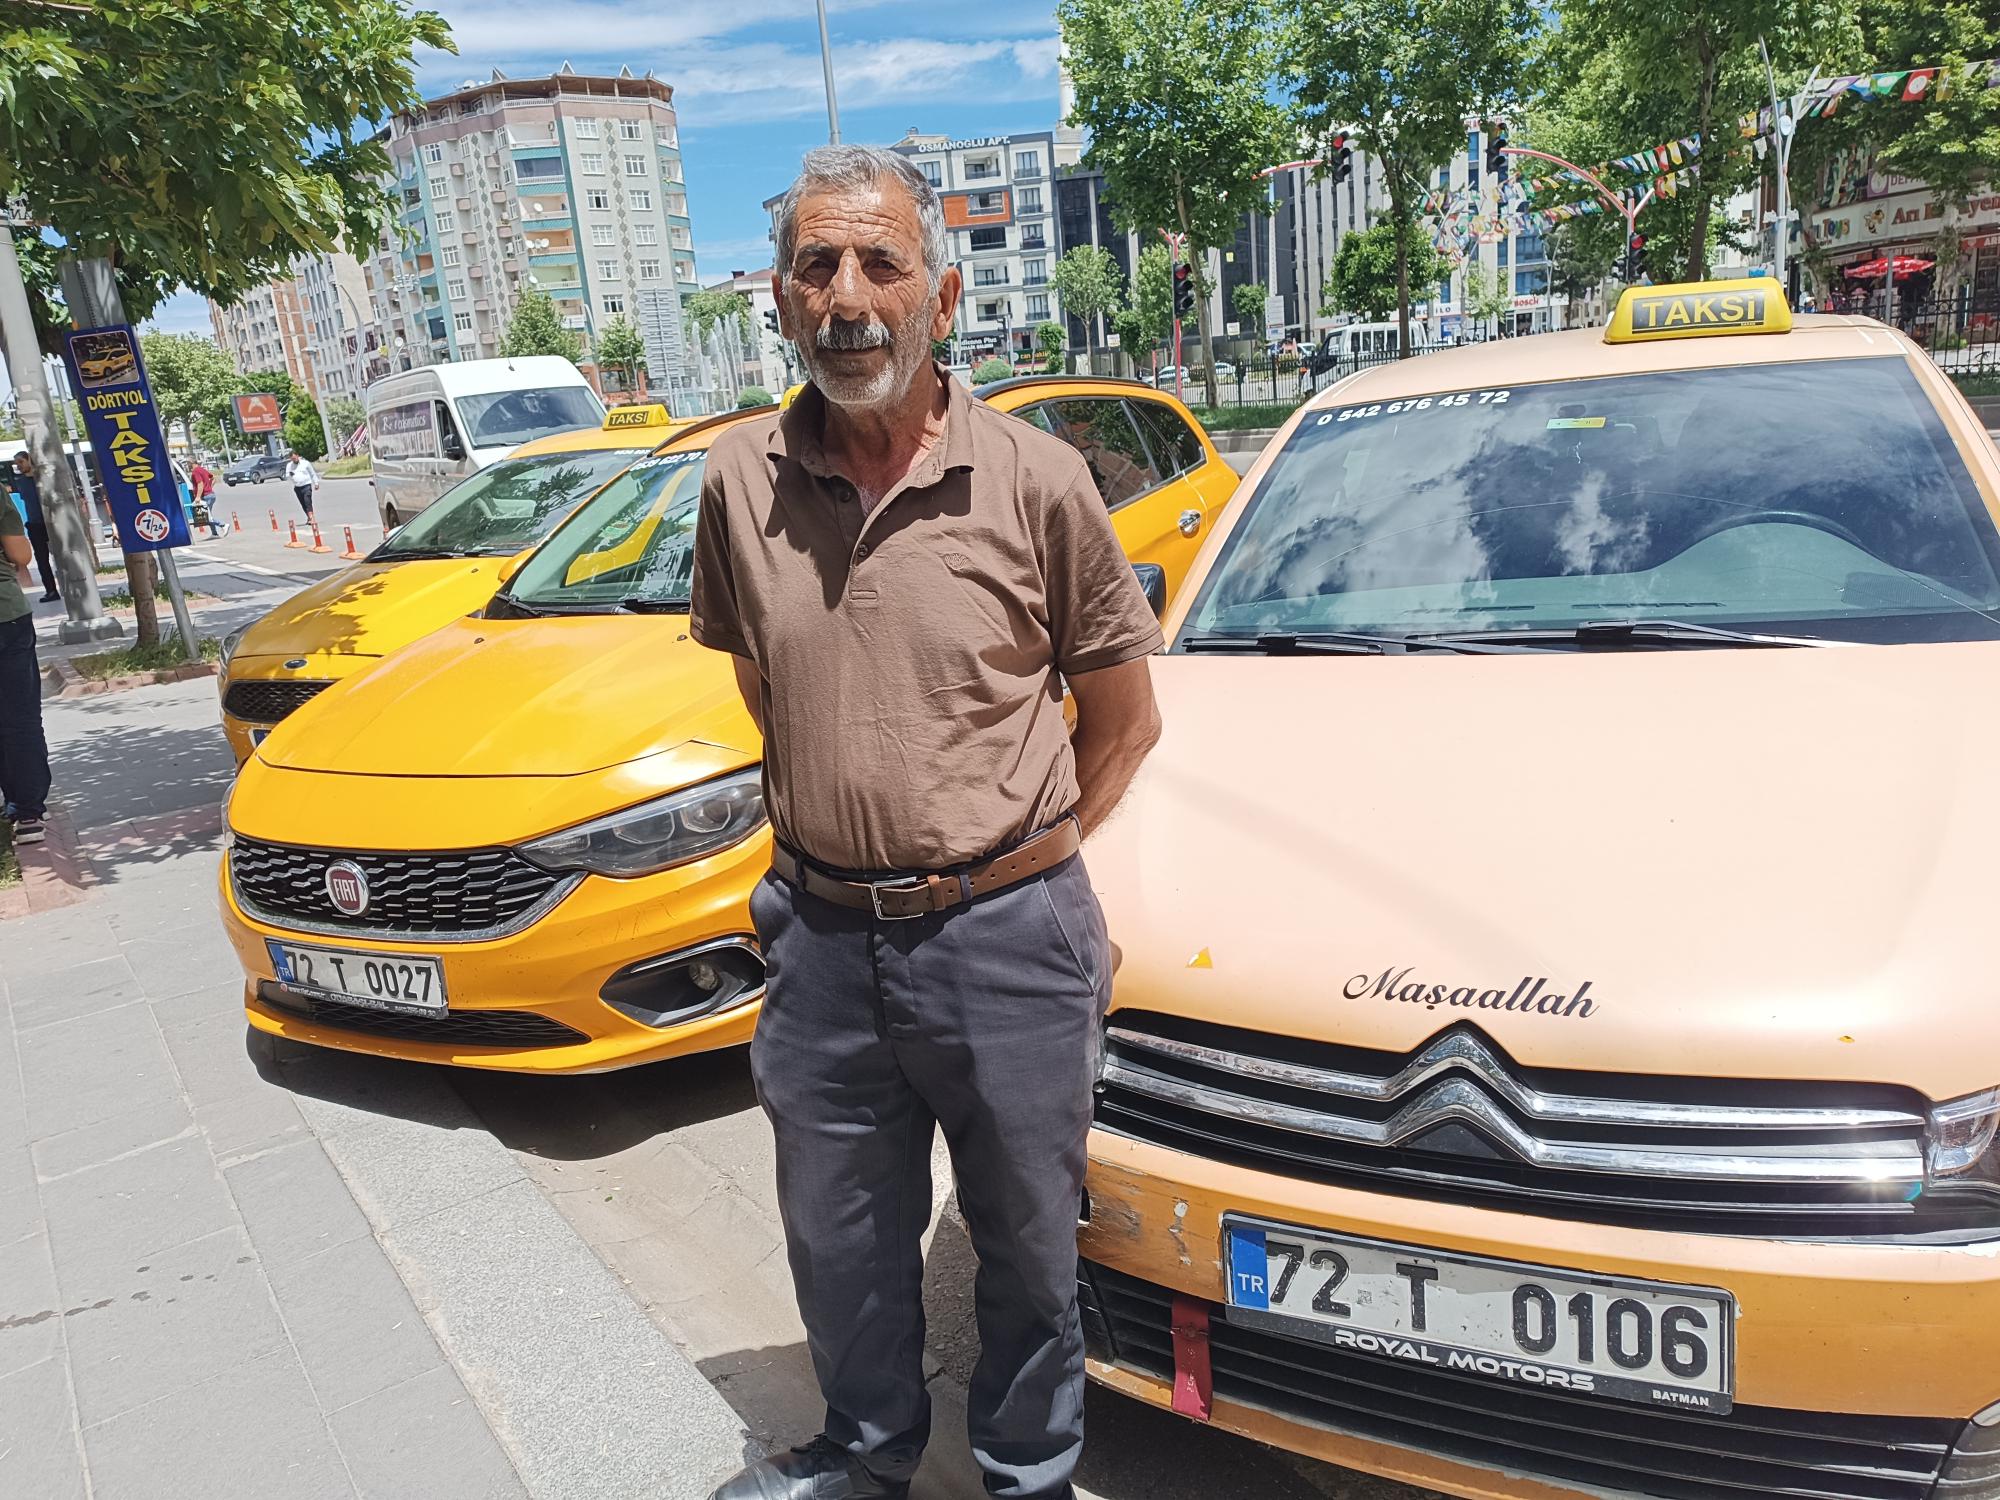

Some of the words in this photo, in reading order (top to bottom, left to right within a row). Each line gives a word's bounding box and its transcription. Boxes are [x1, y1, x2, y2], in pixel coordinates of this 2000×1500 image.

[1642, 295, 1755, 327] TAKSİ
[86, 390, 147, 411] DÖRTYOL
[1317, 413, 1333, 426] 0
[1337, 405, 1381, 422] 542
[1387, 398, 1432, 414] 676
[1438, 393, 1470, 406] 45
[1478, 391, 1510, 404] 72
[104, 411, 155, 504] TAKSİ
[143, 518, 163, 534] 7/24
[333, 879, 357, 901] FIAT
[280, 967, 291, 977] TR
[285, 951, 319, 986] 72
[329, 958, 347, 993] T
[364, 961, 432, 1002] 0027
[1342, 966, 1600, 1018] Maşaallah
[1237, 1272, 1265, 1294] TR
[1266, 1240, 1351, 1317] 72
[1396, 1263, 1439, 1331] T
[1511, 1283, 1709, 1379] 0106
[1335, 1329, 1439, 1365] ROYAL
[1447, 1351, 1595, 1391] MOTORS
[1652, 1389, 1710, 1407] BATMAN
